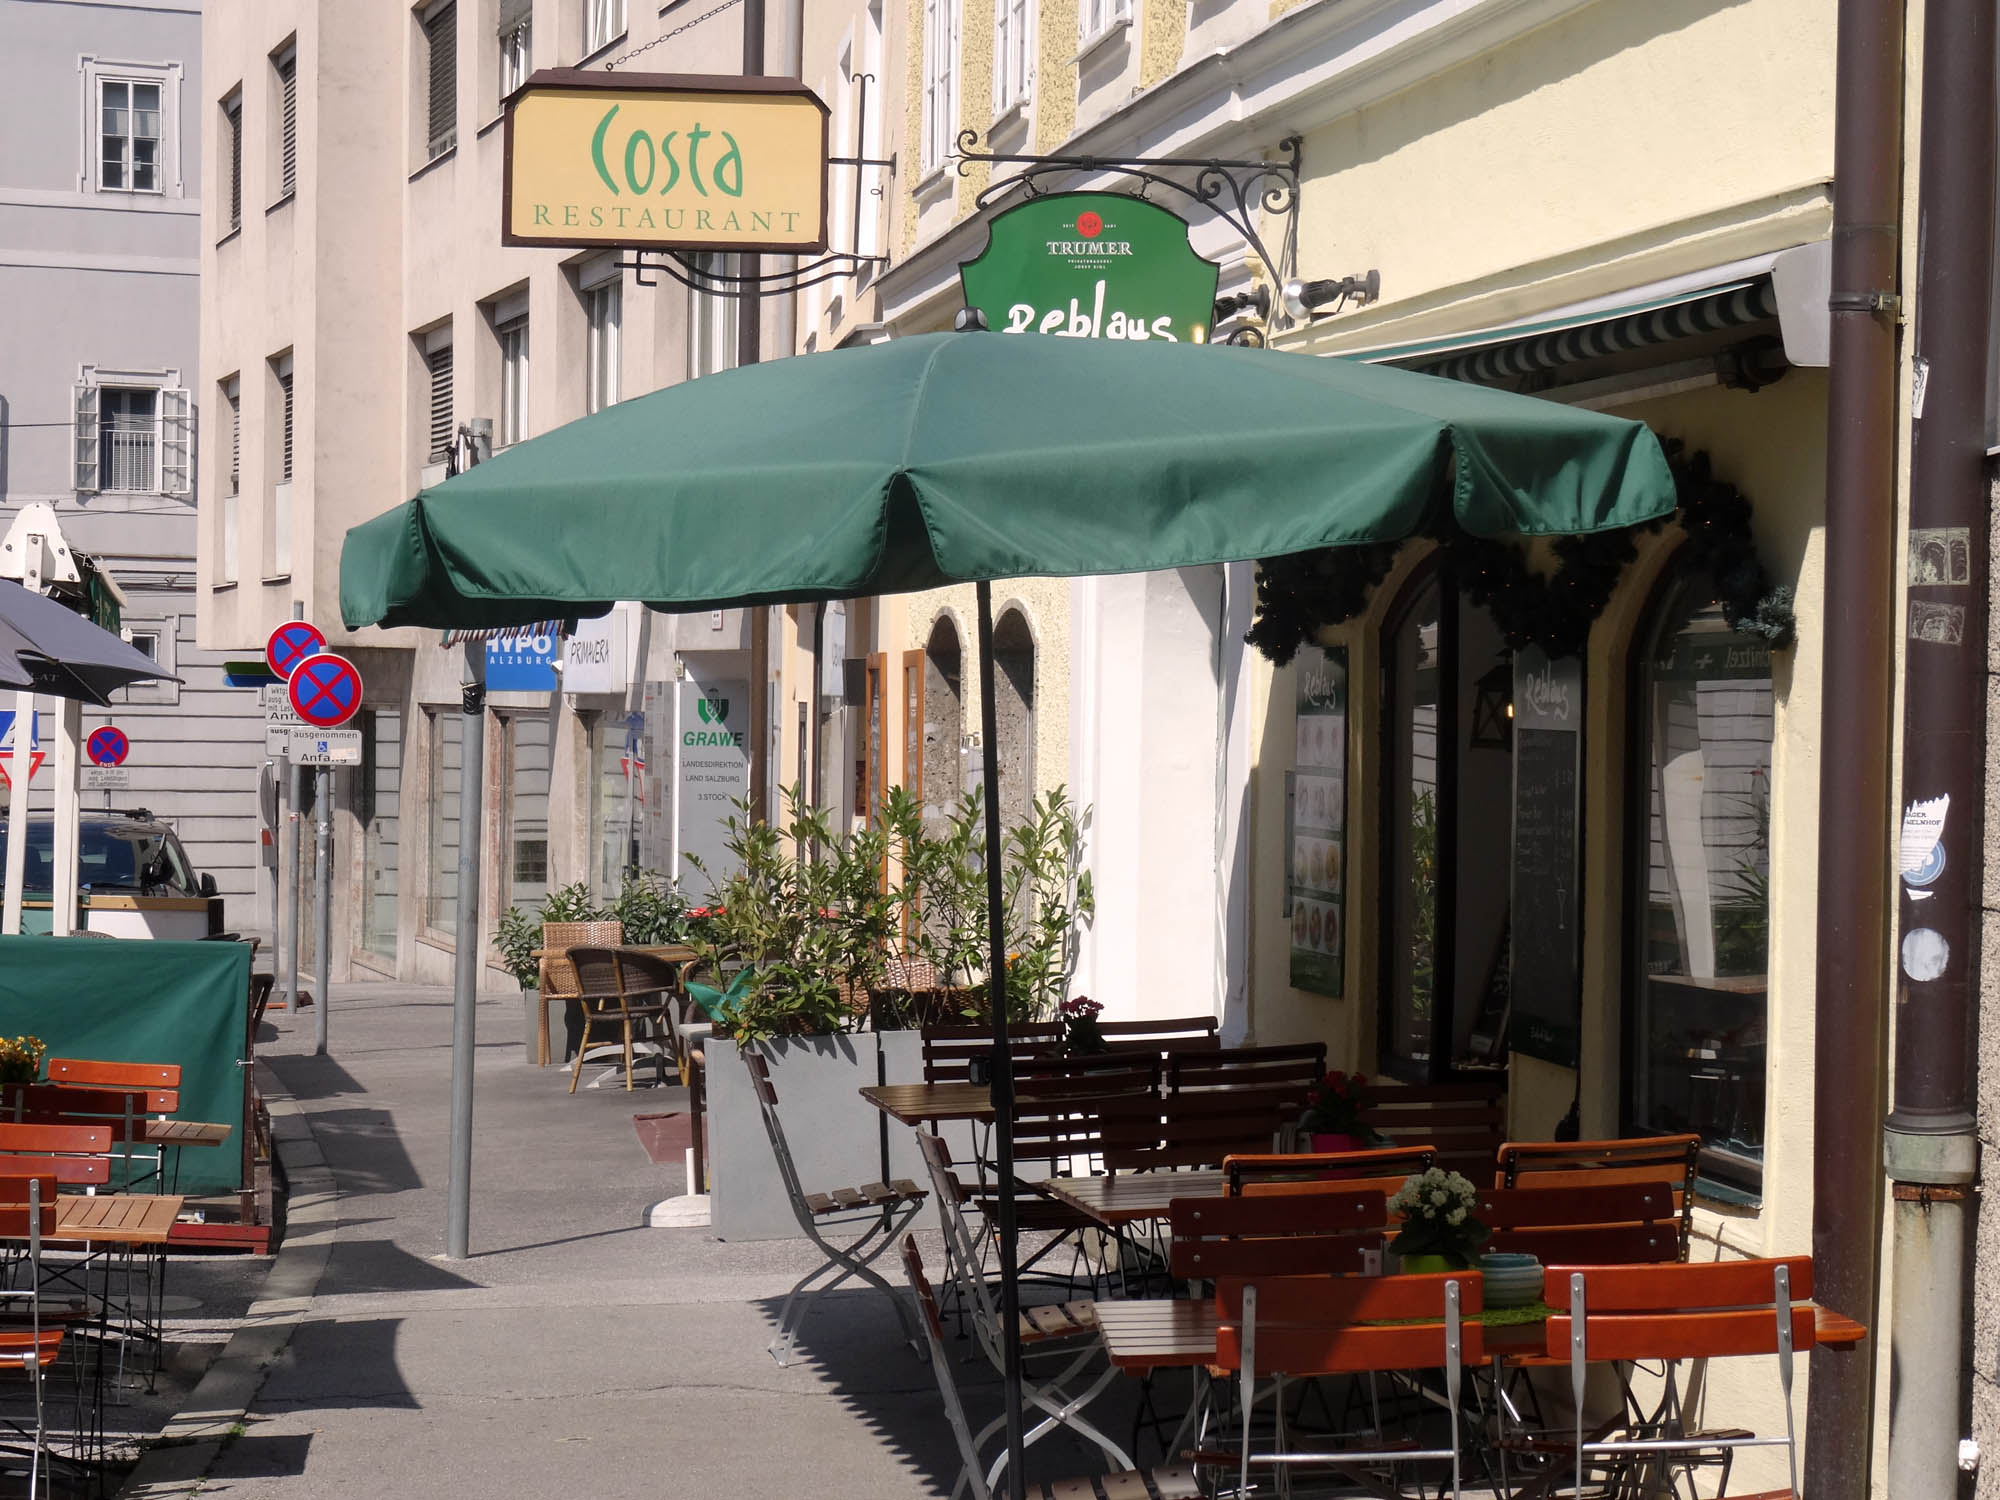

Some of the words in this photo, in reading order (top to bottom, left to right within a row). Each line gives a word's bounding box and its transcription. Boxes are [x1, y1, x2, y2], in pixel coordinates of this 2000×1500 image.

[591, 103, 743, 198] Costa
[532, 203, 801, 233] RESTAURANT
[1046, 241, 1134, 256] TRUMER
[570, 639, 609, 665] PRIMAVERA
[490, 656, 552, 665] ALZBURG
[683, 731, 744, 747] GRAWE
[682, 760, 744, 769] LANDESDIREKTION
[705, 775, 740, 783] SALZBURG
